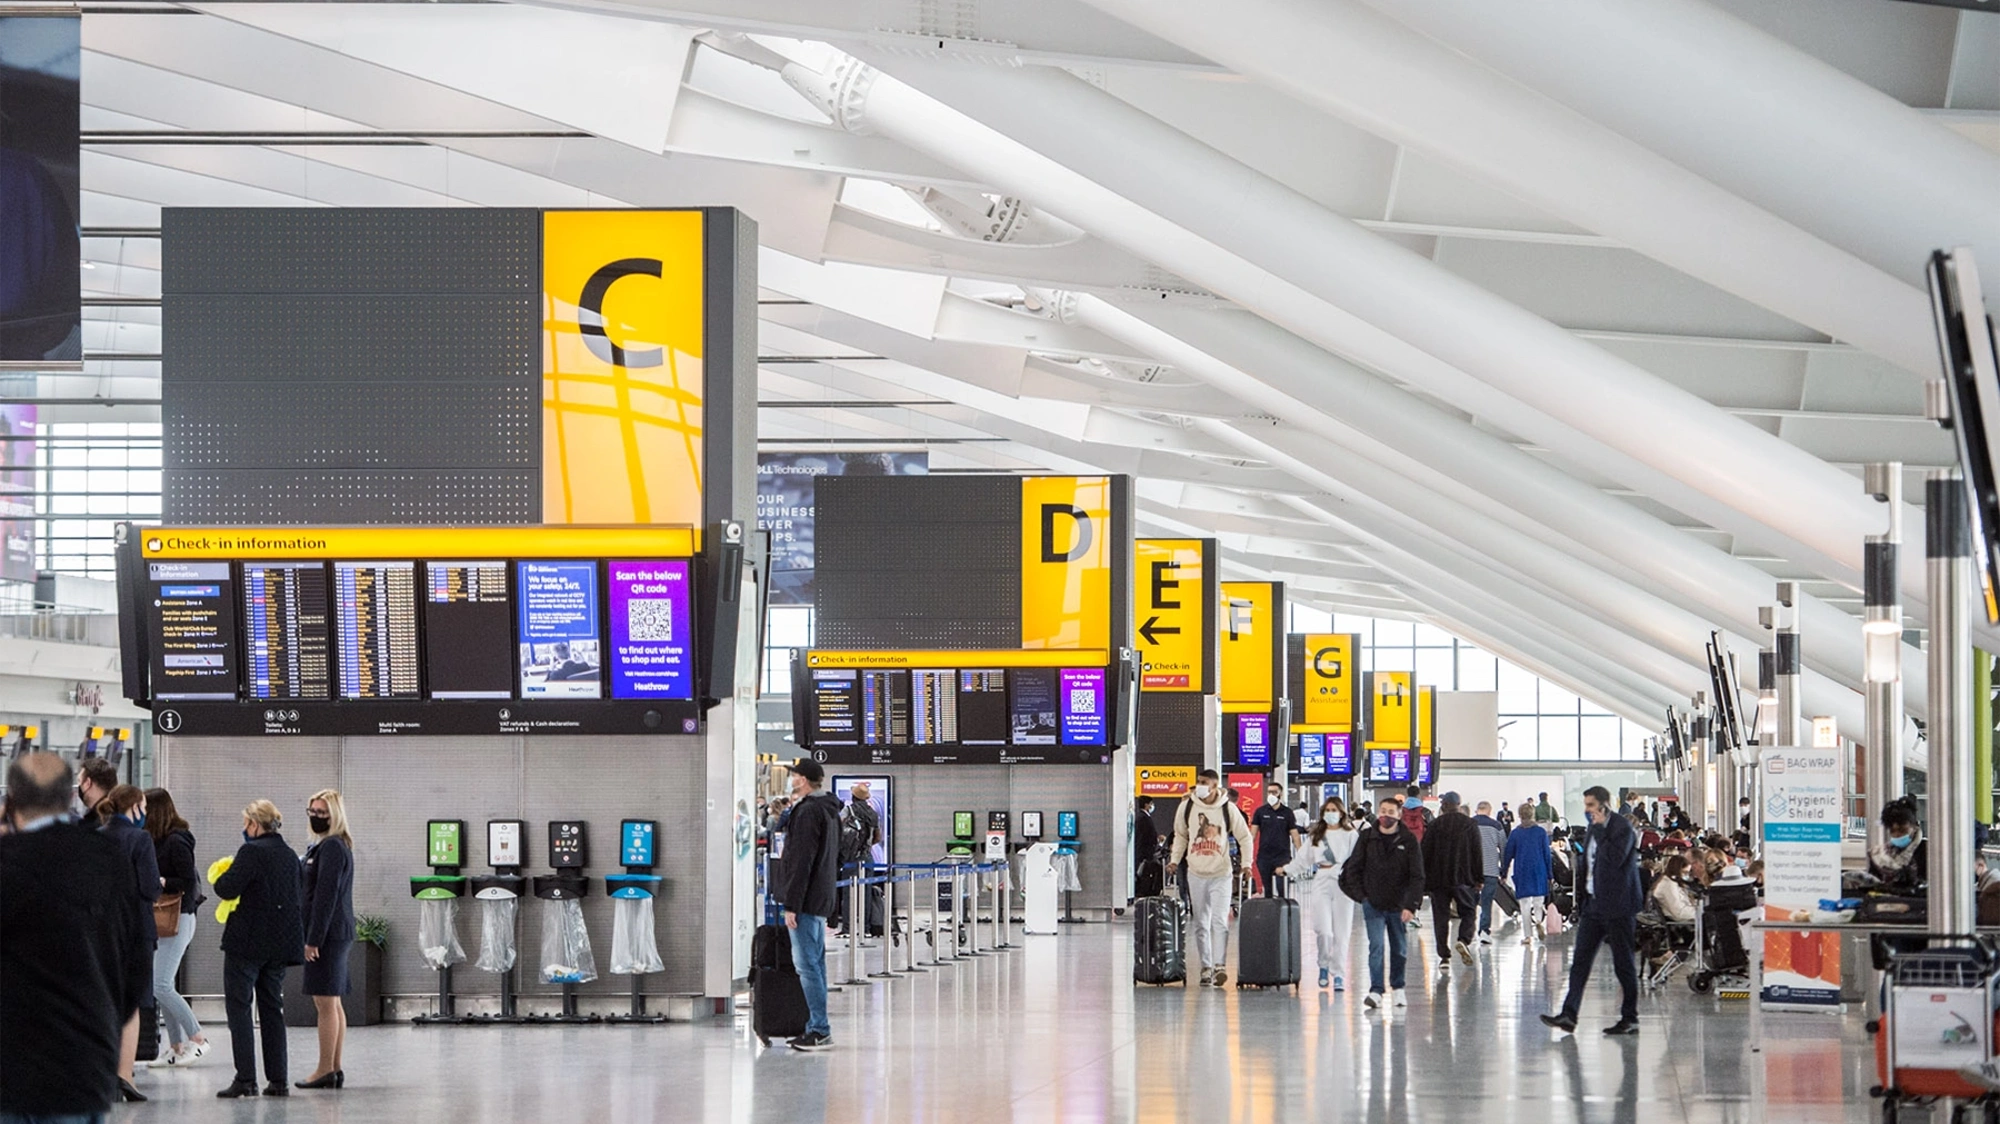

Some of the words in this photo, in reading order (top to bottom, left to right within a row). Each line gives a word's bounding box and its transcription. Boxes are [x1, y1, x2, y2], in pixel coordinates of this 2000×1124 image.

[578, 257, 663, 368] C
[772, 465, 828, 476] Technologies
[757, 494, 785, 504] OUR
[757, 507, 815, 517] USINESS
[758, 520, 793, 529] EVER
[1041, 503, 1093, 563] D
[167, 537, 232, 550] Check-in
[237, 537, 327, 550] information
[615, 571, 637, 581] Scan
[637, 570, 653, 581] the
[653, 570, 682, 581] below
[630, 584, 645, 595] QR
[645, 583, 667, 593] code
[1151, 561, 1181, 609] E
[1229, 600, 1253, 641] F
[618, 646, 628, 654] to
[628, 645, 644, 654] find
[644, 646, 658, 654] out
[658, 645, 683, 654] where
[630, 655, 650, 664] shop
[650, 655, 666, 663] and
[821, 656, 857, 664] Check-in
[858, 655, 908, 664] information
[1313, 647, 1342, 678] G
[1154, 662, 1190, 670] Check-in
[633, 682, 670, 690] Heathrow
[1382, 682, 1402, 706] H
[1787, 758, 1807, 768] BAG
[1809, 758, 1836, 768] WRAP
[1152, 770, 1188, 778] Check-in
[1789, 795, 1836, 807] Hygienic
[1789, 808, 1825, 819] Shield
